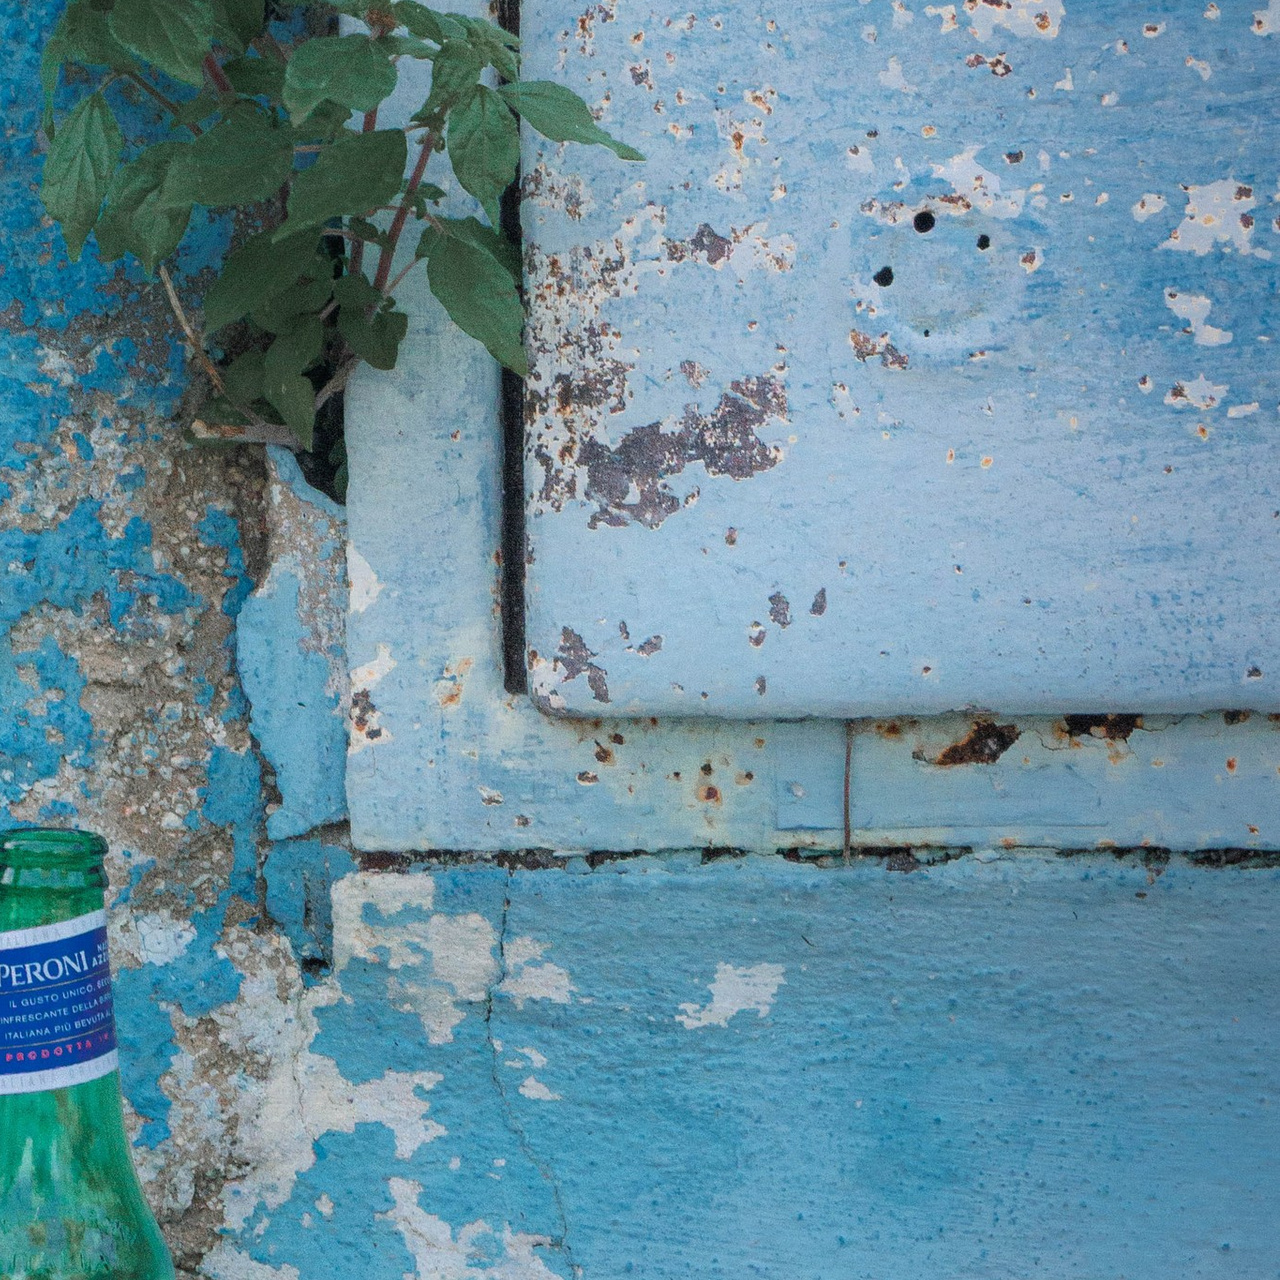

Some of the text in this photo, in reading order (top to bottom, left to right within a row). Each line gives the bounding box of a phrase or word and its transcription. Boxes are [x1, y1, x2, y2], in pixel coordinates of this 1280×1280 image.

[9, 1000, 18, 1009] IL
[21, 993, 59, 1007] GUSTO
[72, 998, 98, 1014] DELLA
[5, 1026, 51, 1040] ITALIANA
[54, 1021, 71, 1033] PIÙ
[74, 1011, 105, 1029] BEVUTA
